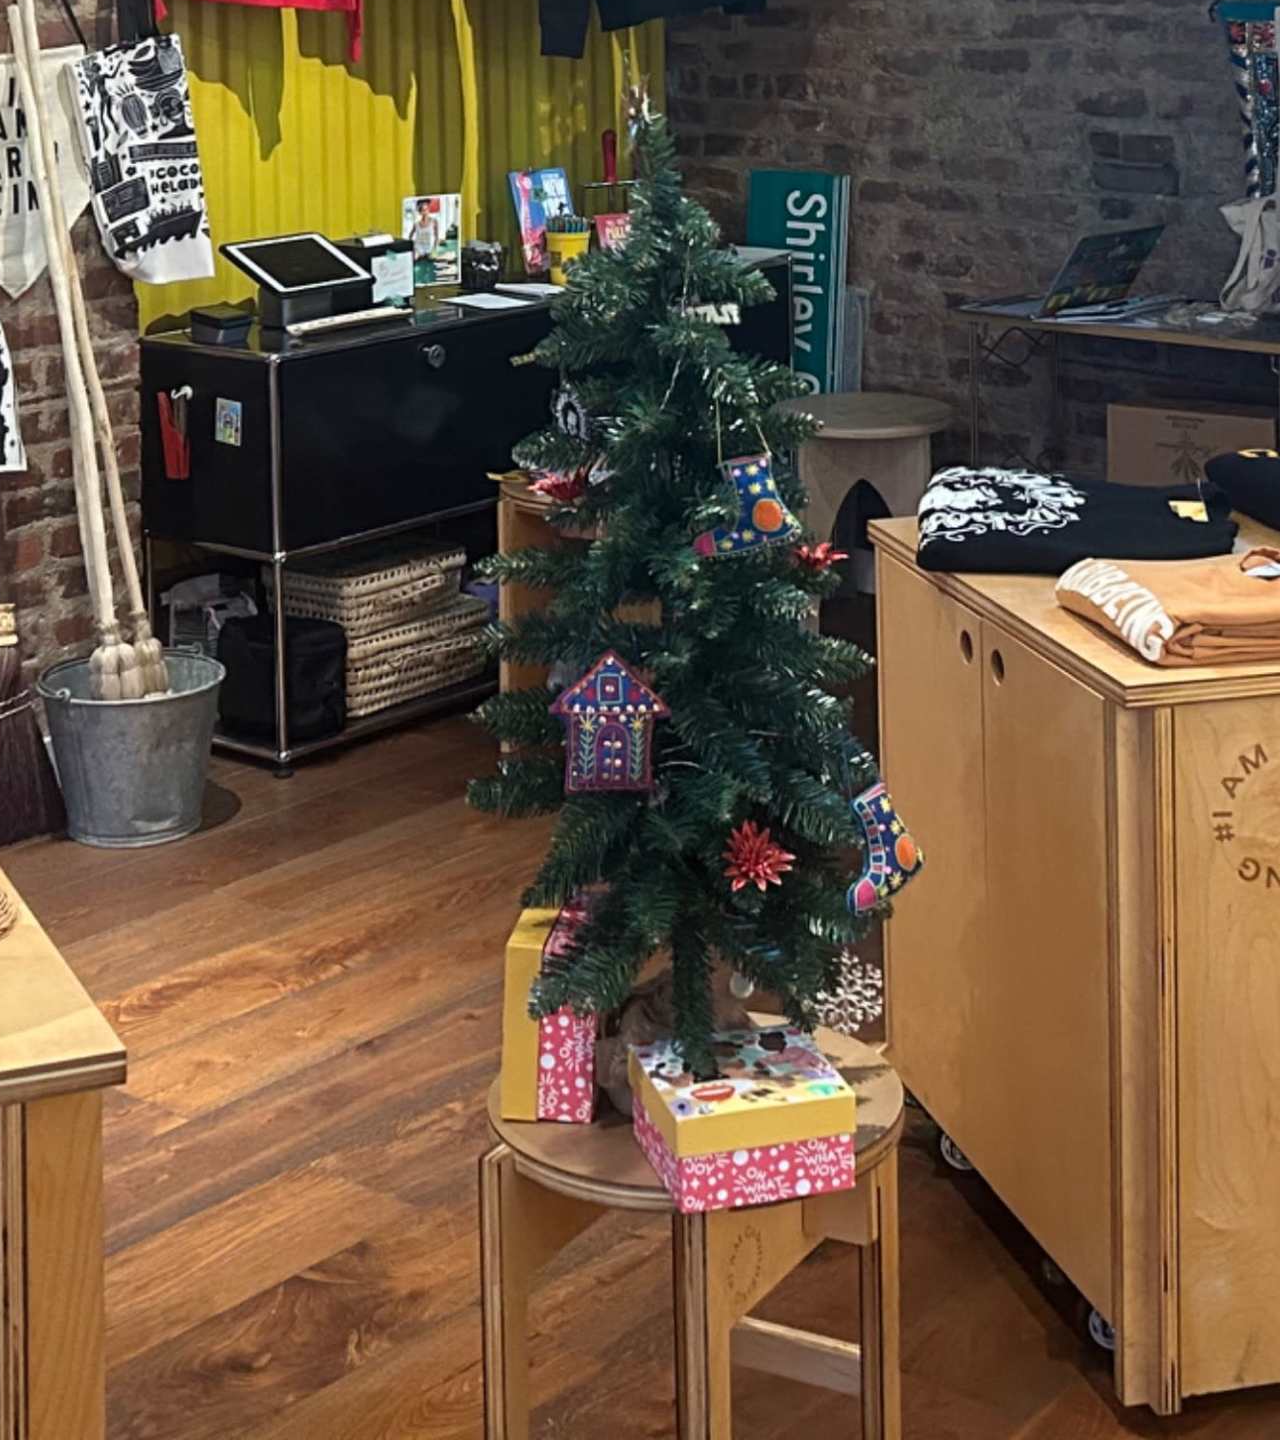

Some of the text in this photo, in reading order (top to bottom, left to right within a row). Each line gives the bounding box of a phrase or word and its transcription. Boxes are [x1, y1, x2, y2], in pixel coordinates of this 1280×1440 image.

[8, 77, 15, 107] I
[786, 190, 828, 353] Shirley
[804, 1147, 845, 1166] WHAT
[685, 1161, 715, 1176] JOY
[810, 1165, 839, 1177] JOY
[742, 1175, 785, 1195] WHAT
